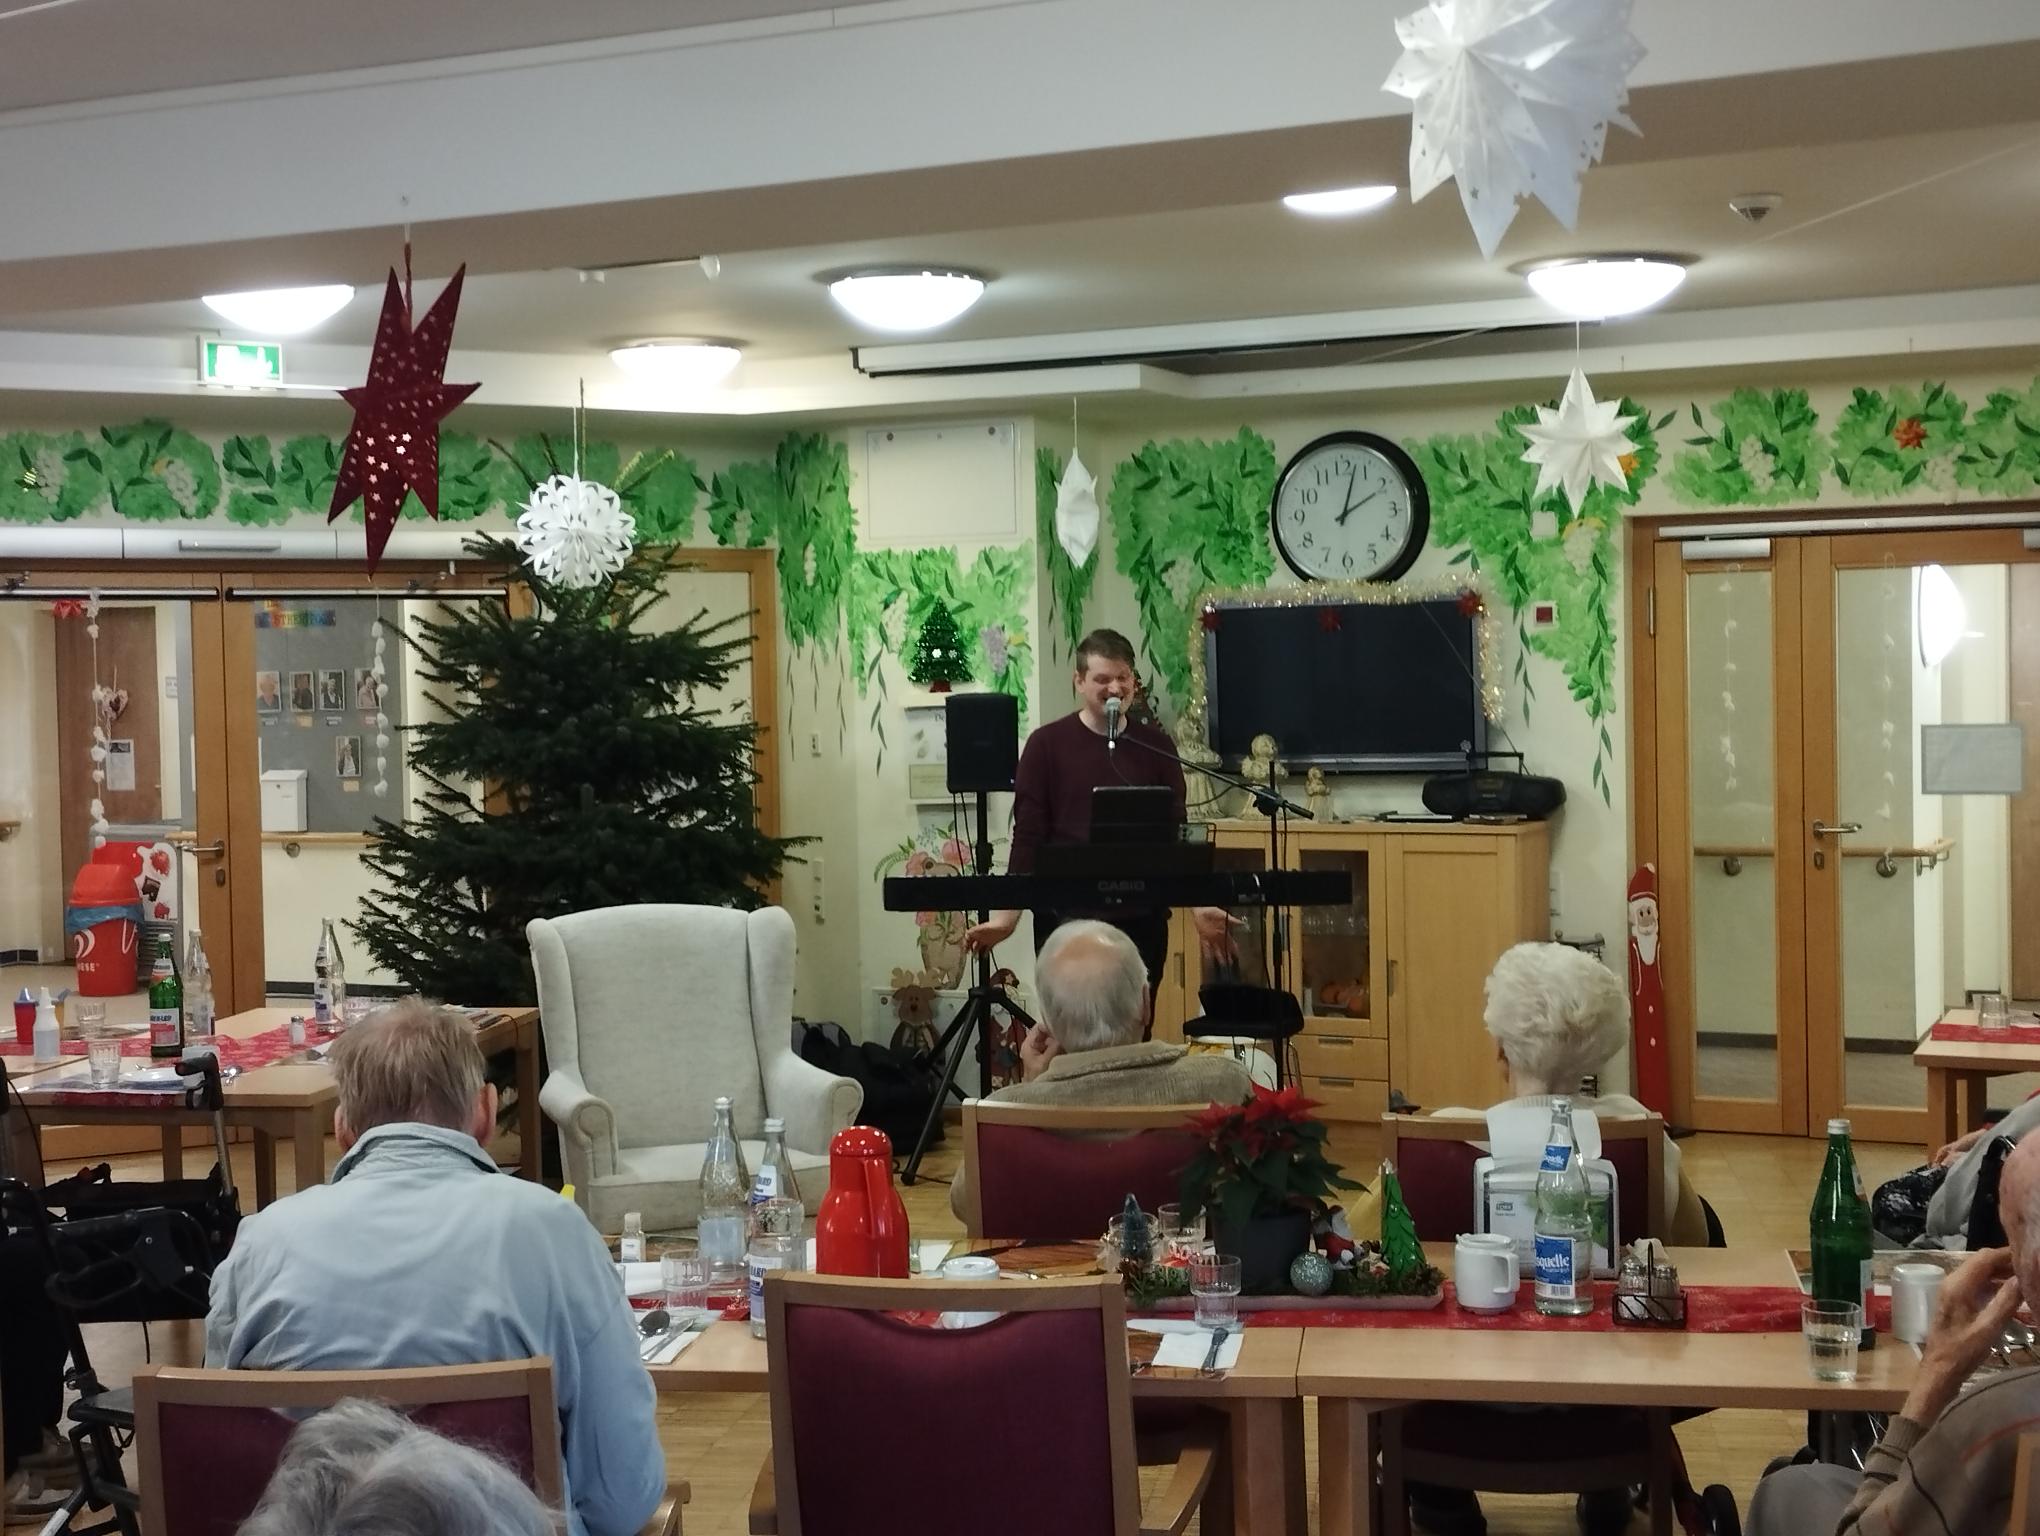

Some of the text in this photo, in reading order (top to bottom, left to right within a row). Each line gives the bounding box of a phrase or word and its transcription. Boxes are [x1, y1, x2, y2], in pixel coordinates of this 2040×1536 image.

[1334, 459, 1352, 476] 12
[1315, 468, 1329, 485] 11
[1375, 477, 1388, 493] 2
[1301, 488, 1318, 505] 10
[1294, 509, 1305, 527] 9
[1388, 501, 1398, 518] 3
[1302, 532, 1314, 549] 8
[1341, 551, 1354, 569] 6
[1098, 881, 1145, 891] CASIO
